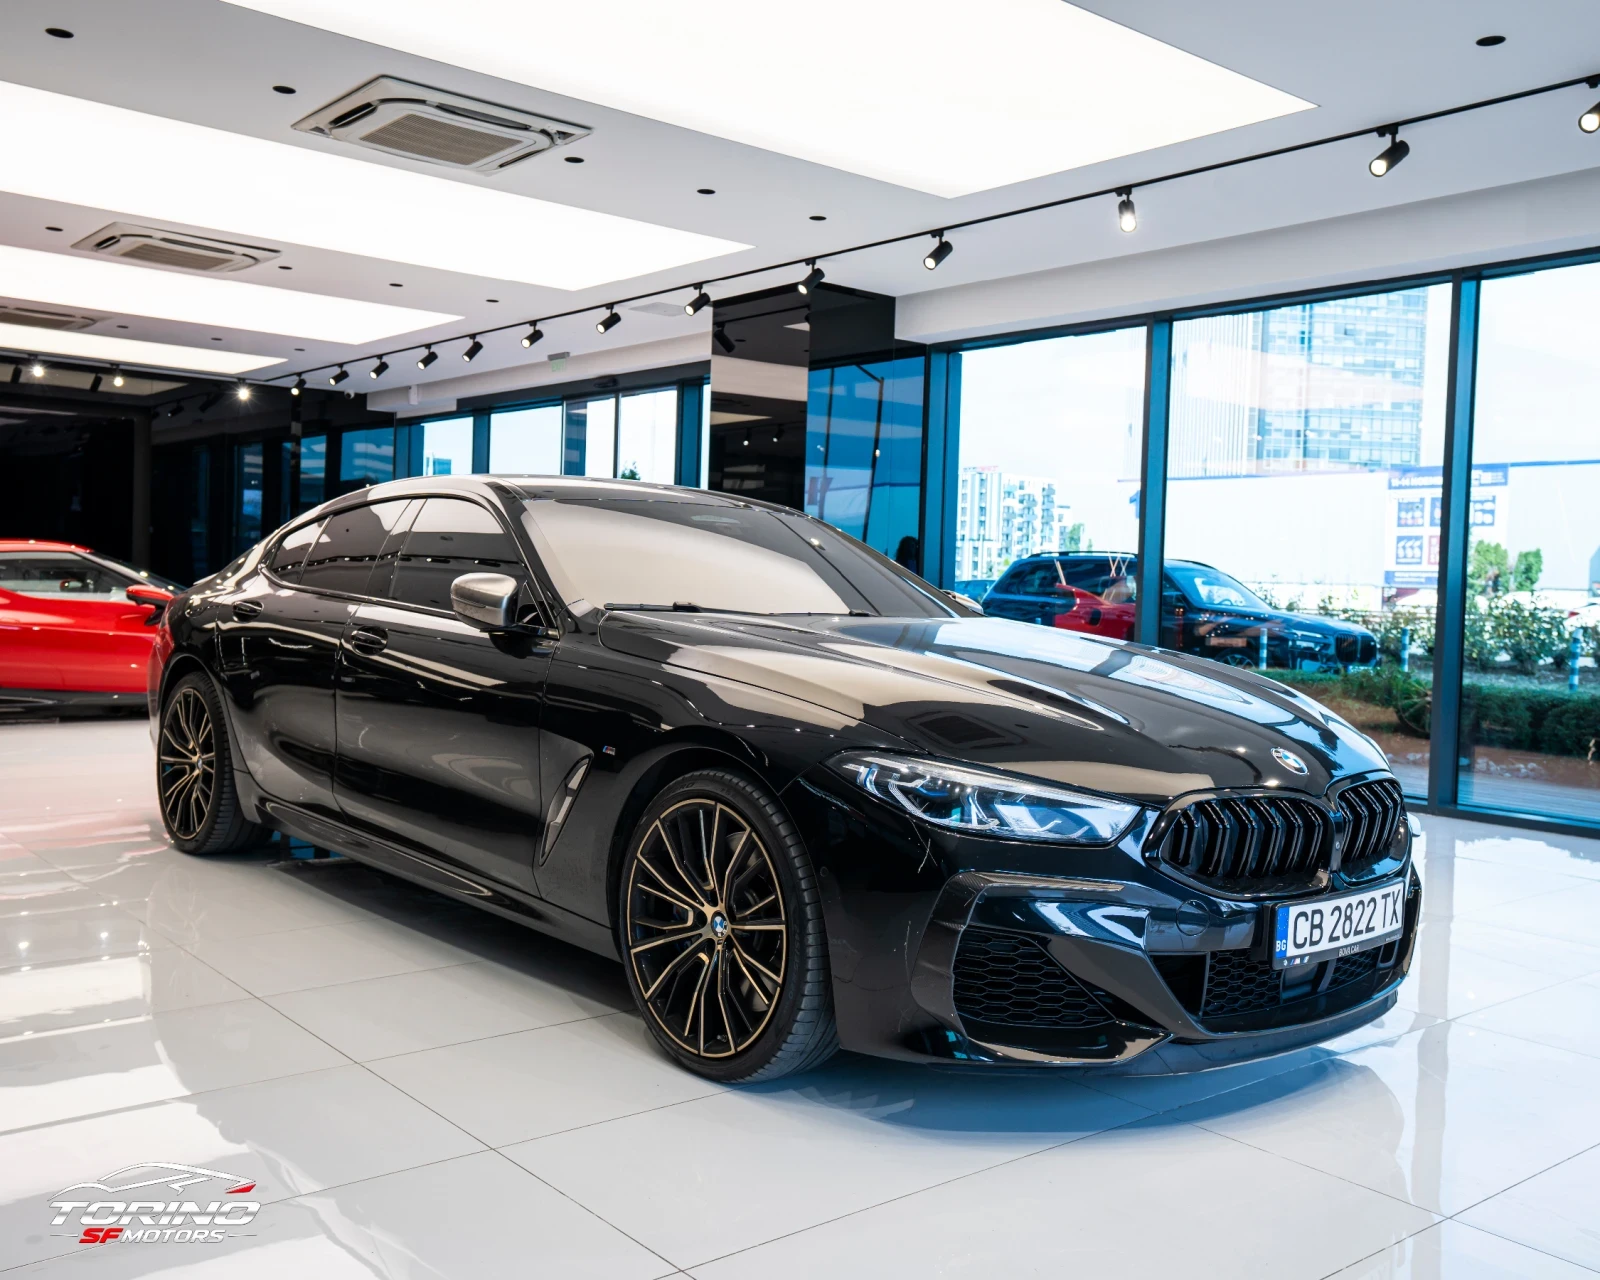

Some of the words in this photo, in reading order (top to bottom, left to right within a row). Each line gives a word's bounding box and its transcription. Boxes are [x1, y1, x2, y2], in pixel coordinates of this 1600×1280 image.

[1293, 908, 1324, 949] CB
[1328, 897, 1377, 943] 2822
[1381, 889, 1401, 929] TX
[1275, 939, 1287, 952] BG
